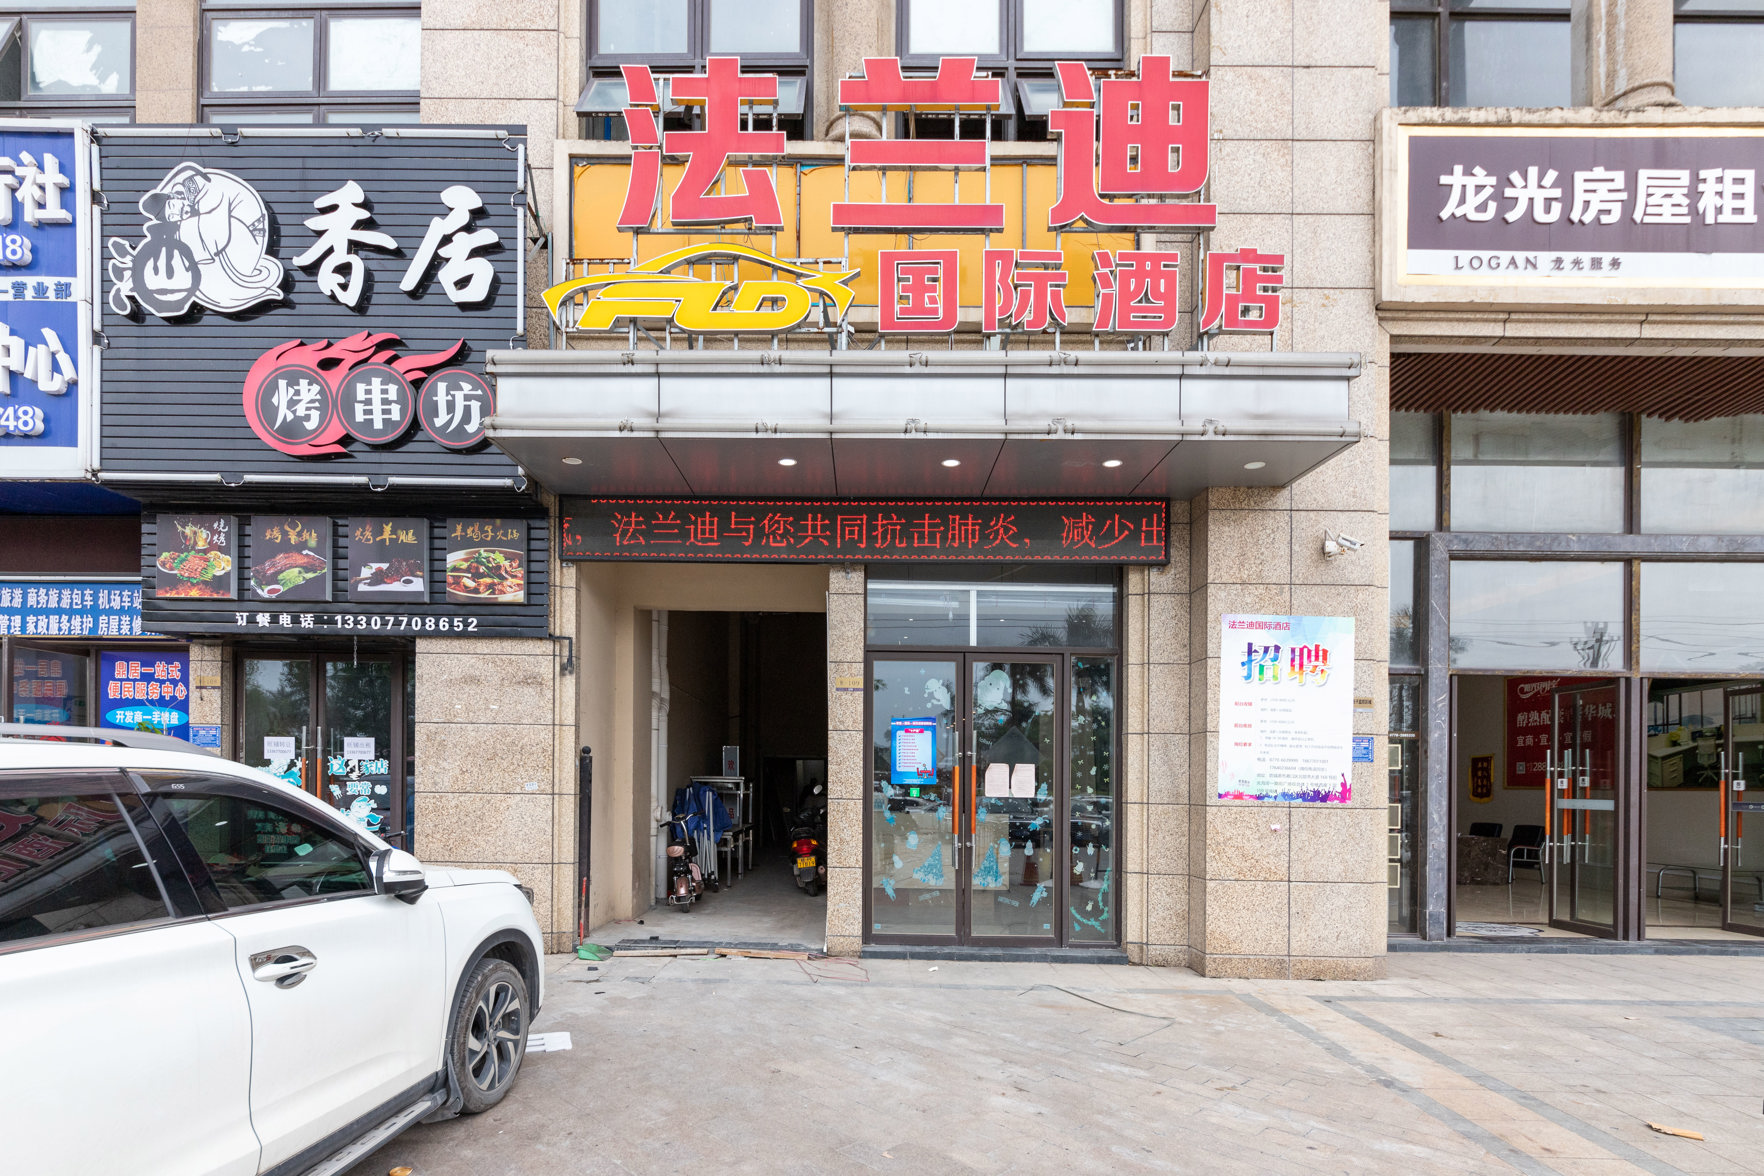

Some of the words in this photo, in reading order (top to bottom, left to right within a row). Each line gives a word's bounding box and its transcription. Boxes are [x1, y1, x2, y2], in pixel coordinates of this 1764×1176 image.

[616, 55, 1217, 231] 法兰迪
[0, 150, 72, 226] 社
[292, 180, 500, 307] 香居
[1454, 255, 1538, 271] LOGAN
[1551, 256, 1623, 271] 龙光服务
[879, 248, 1286, 332] 国际酒店
[271, 377, 483, 434] 烤串坊
[27, 587, 94, 609] 商务旅游包车
[26, 614, 94, 636] 家政服务维护
[1228, 620, 1291, 631] 法兰迪国际酒店
[115, 661, 181, 679] 鼎居一站式
[1241, 642, 1332, 687] 招聘
[108, 681, 187, 700] 便民服务中心
